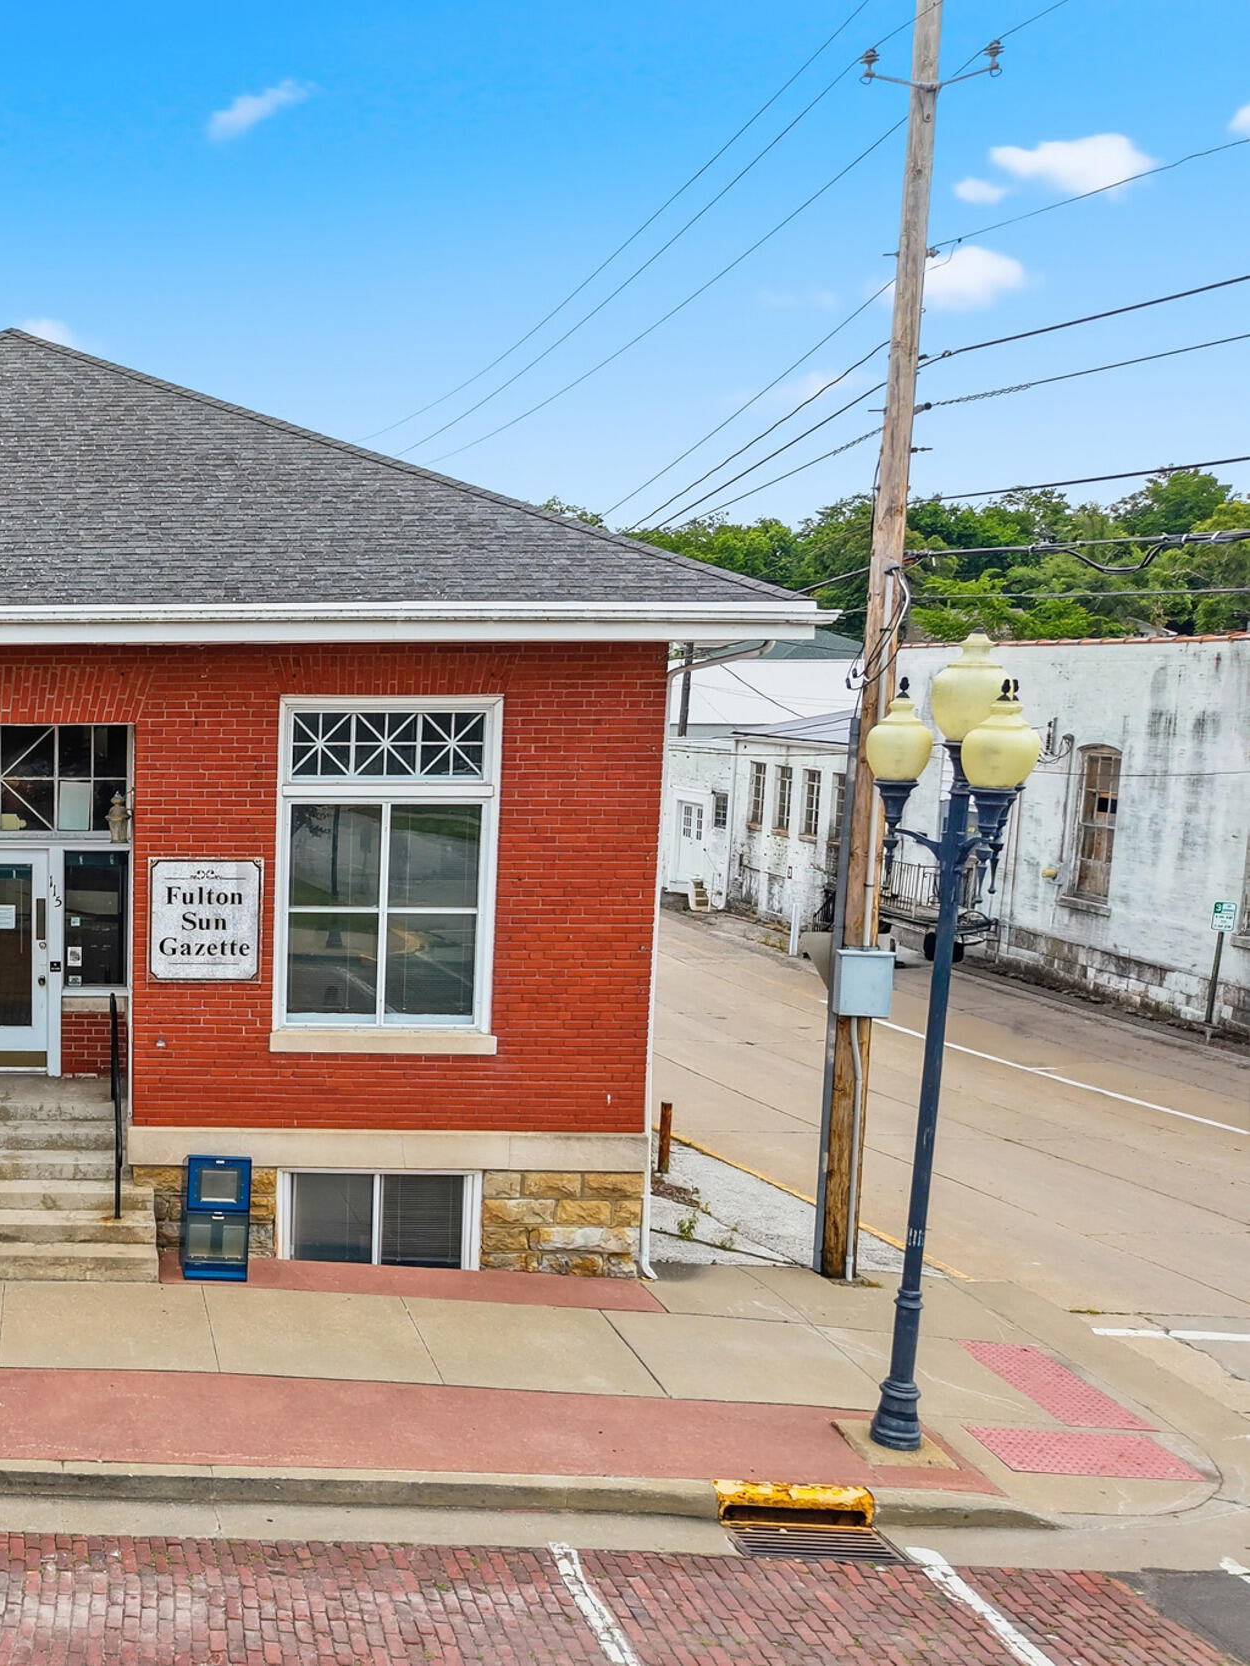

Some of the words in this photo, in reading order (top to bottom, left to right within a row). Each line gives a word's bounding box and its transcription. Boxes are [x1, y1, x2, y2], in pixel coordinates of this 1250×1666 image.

[165, 886, 243, 905] Fulton
[181, 911, 227, 931] Sun
[159, 937, 250, 956] Gazette
